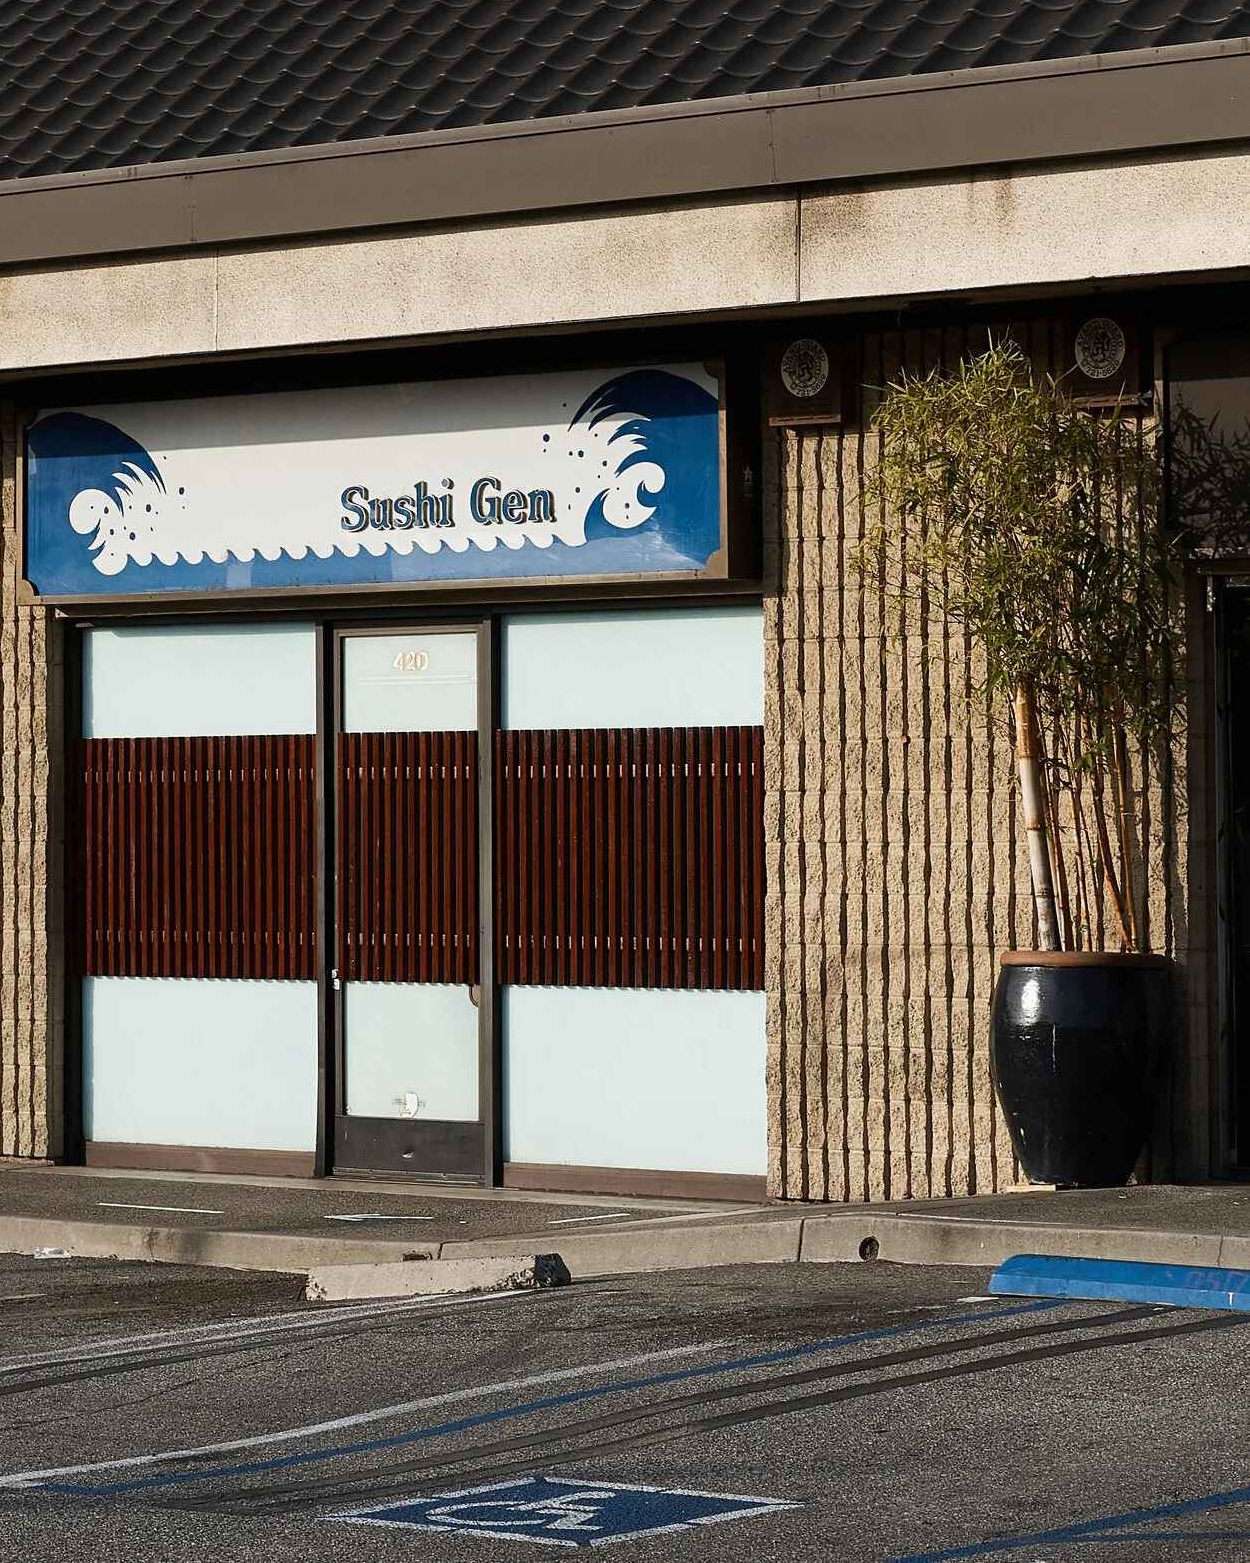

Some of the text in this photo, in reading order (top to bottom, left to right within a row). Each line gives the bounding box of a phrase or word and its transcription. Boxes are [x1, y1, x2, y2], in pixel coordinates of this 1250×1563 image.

[341, 476, 558, 533] Sushi Gen
[393, 651, 430, 671] 420
